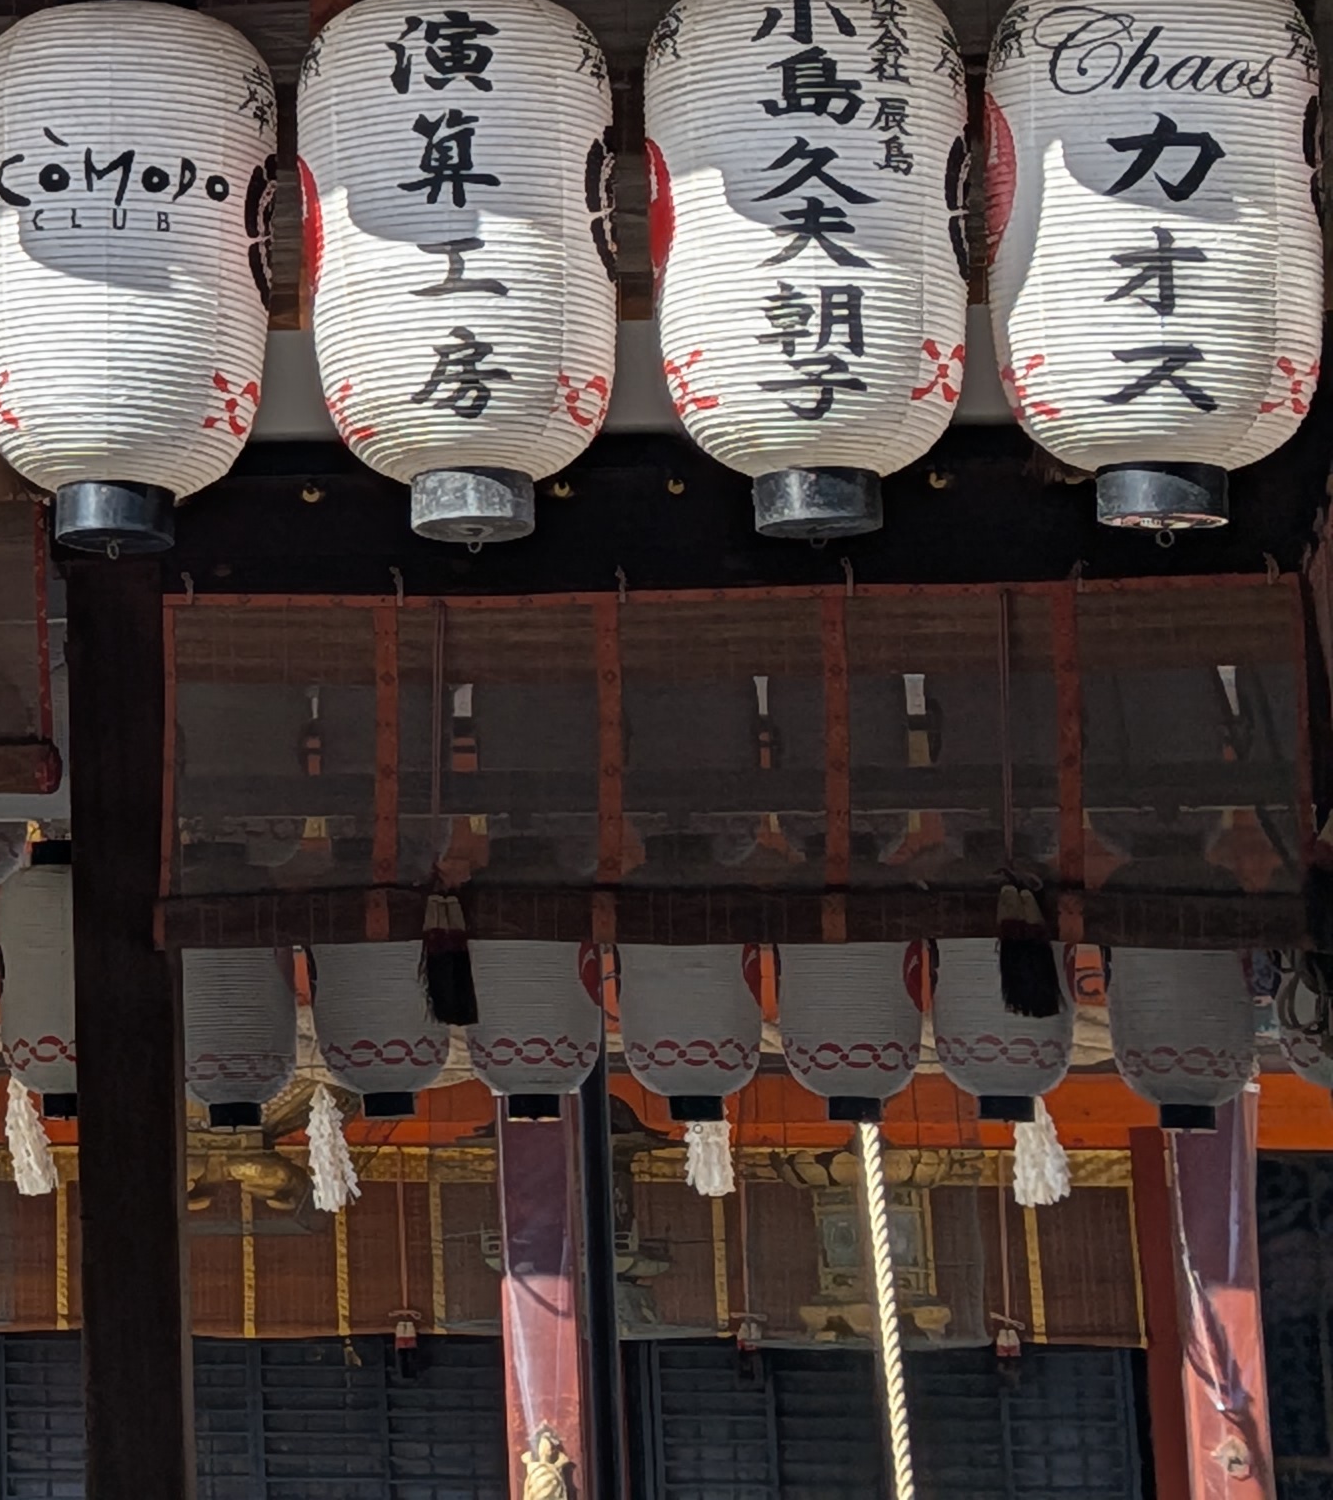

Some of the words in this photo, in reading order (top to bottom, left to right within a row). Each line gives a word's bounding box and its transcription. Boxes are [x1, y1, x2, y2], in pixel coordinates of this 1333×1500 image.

[1033, 5, 1275, 100] Chaos
[32, 208, 171, 233] CLUB
[387, 10, 513, 419] 演算工房
[1103, 112, 1226, 412] カオス
